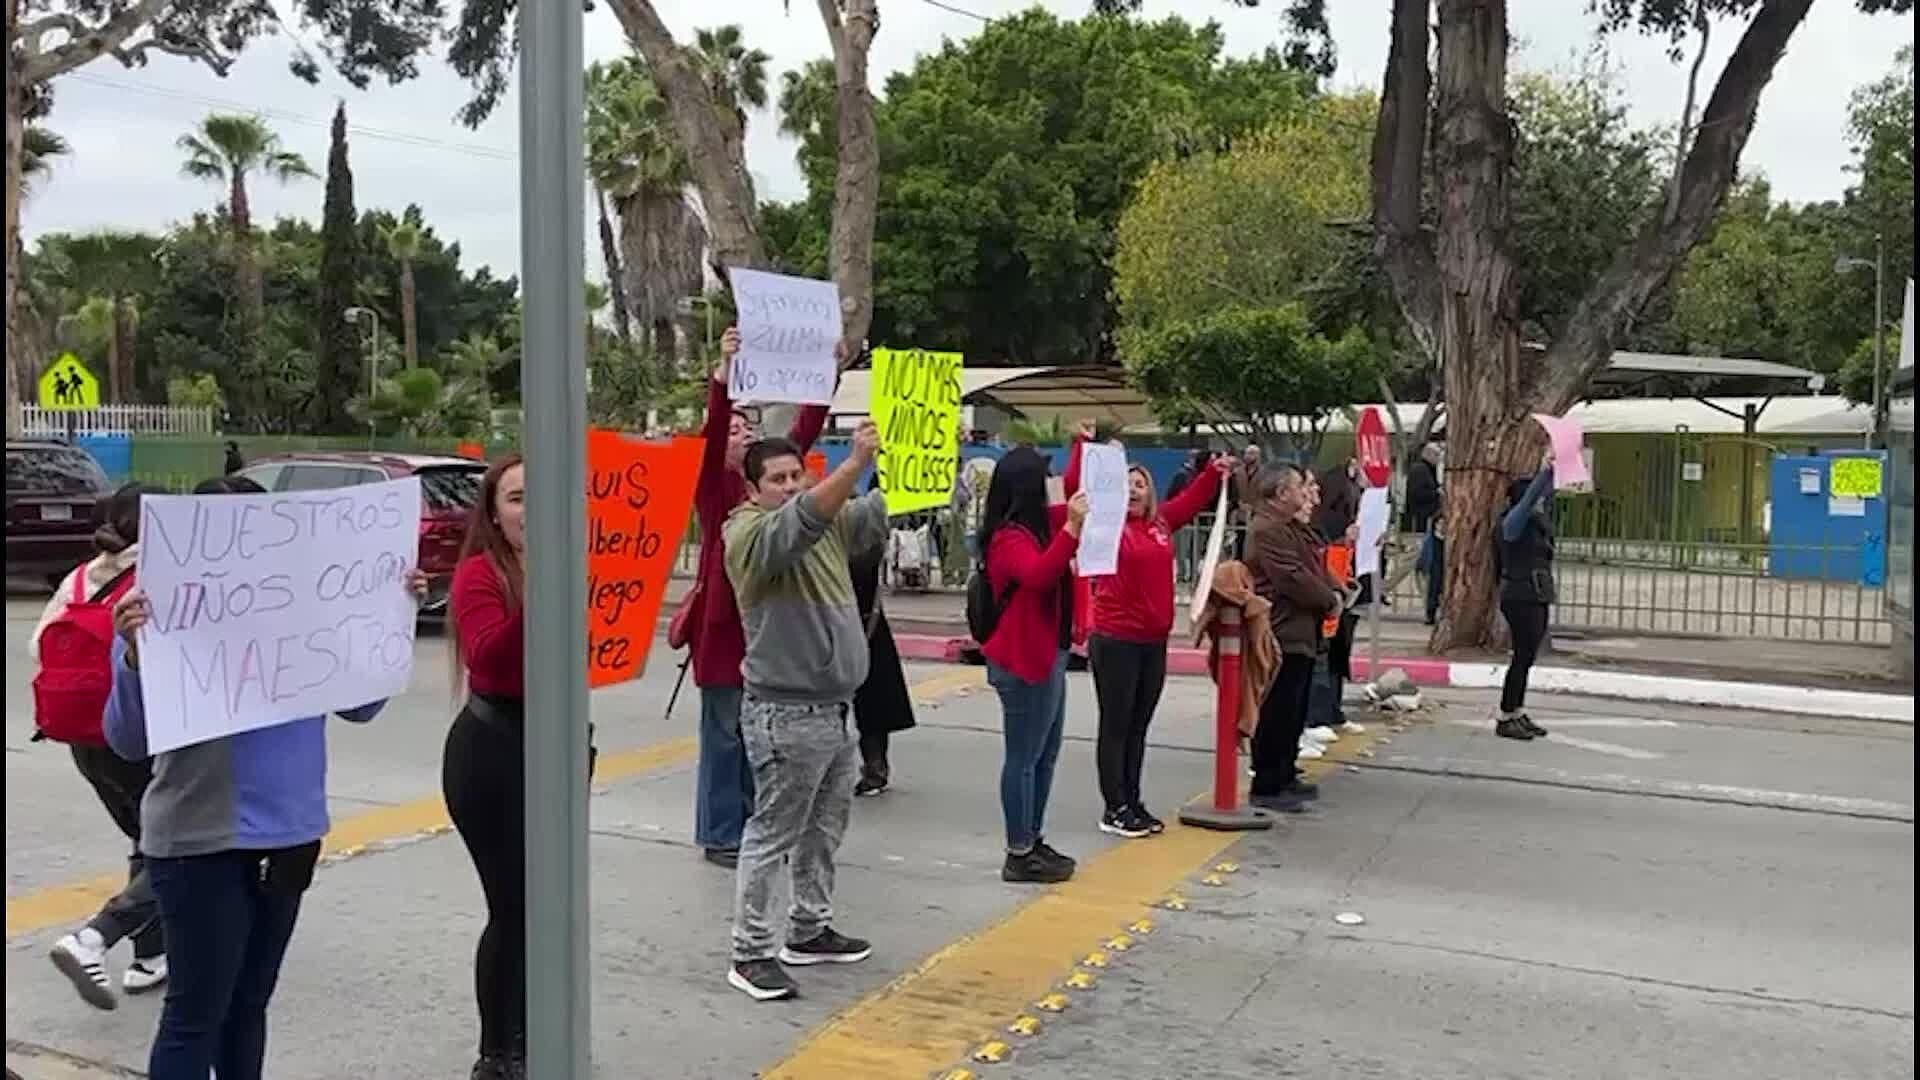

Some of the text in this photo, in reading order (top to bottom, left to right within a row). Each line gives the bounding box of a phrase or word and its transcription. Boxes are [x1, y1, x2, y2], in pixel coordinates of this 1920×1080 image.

[733, 359, 758, 393] No
[883, 352, 917, 400] NO
[587, 462, 649, 509] UIS
[141, 492, 402, 572] NUESTROS
[142, 571, 294, 643] NIÑOS
[180, 612, 411, 730] MAESTROS
